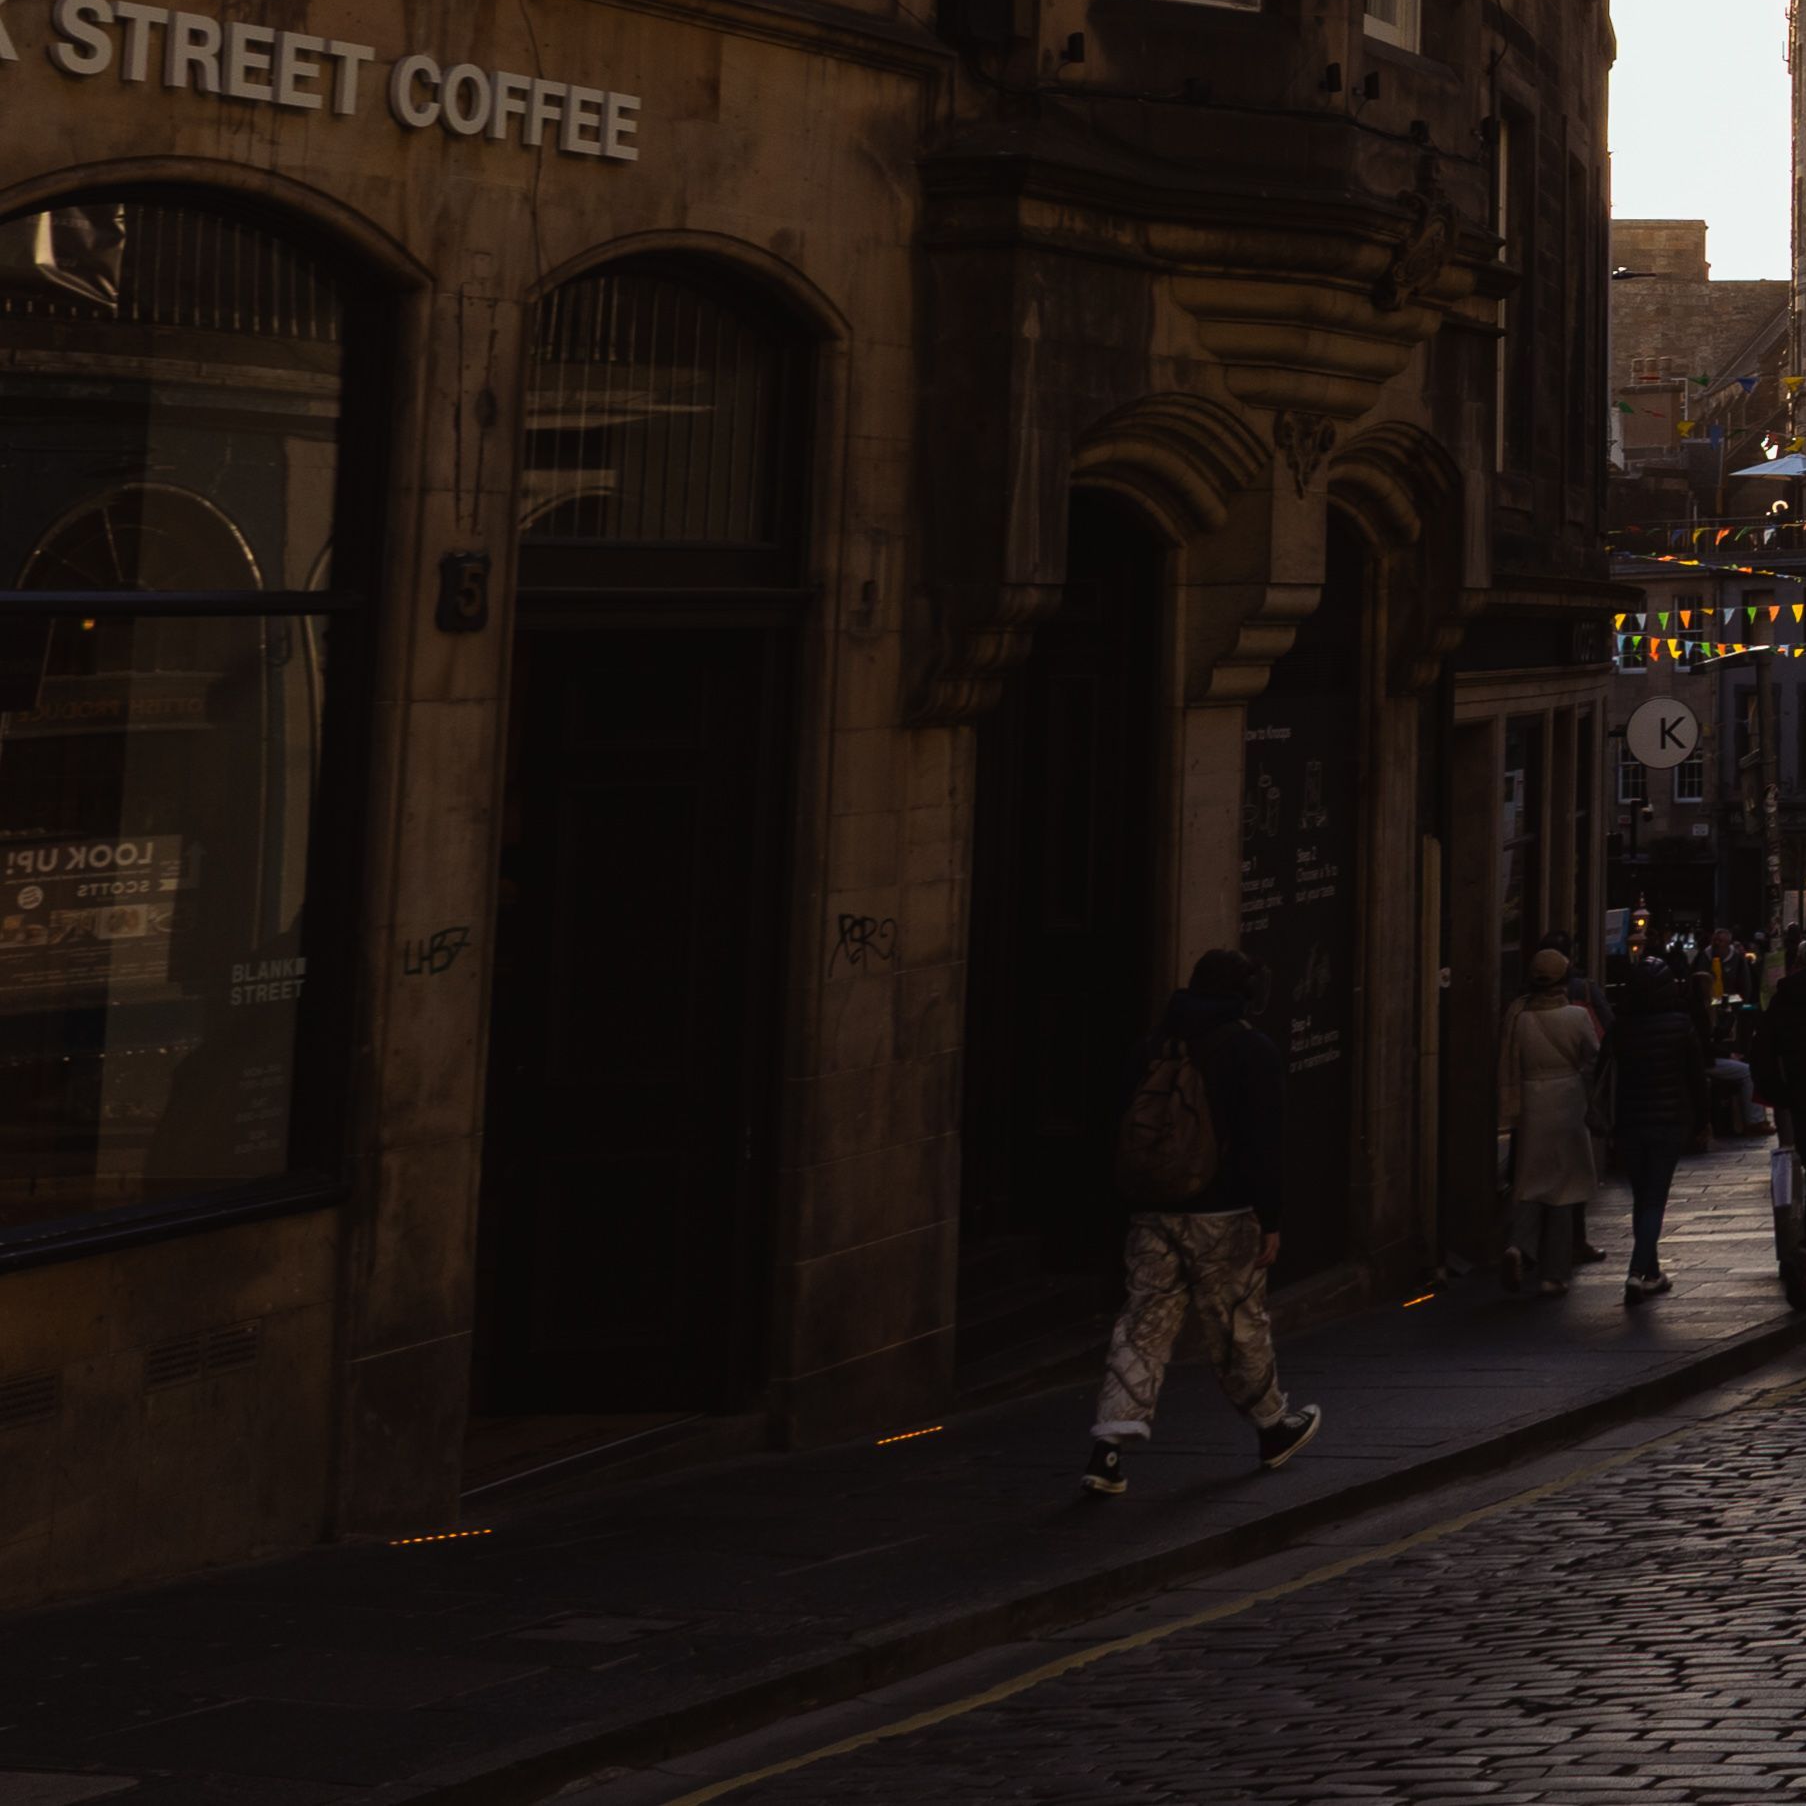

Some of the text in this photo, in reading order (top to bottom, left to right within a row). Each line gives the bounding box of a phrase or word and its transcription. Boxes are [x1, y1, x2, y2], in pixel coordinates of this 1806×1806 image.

[390, 53, 644, 163] COFFEE
[456, 563, 483, 617] 5
[1660, 716, 1686, 749] K
[230, 979, 305, 1007] STREET
